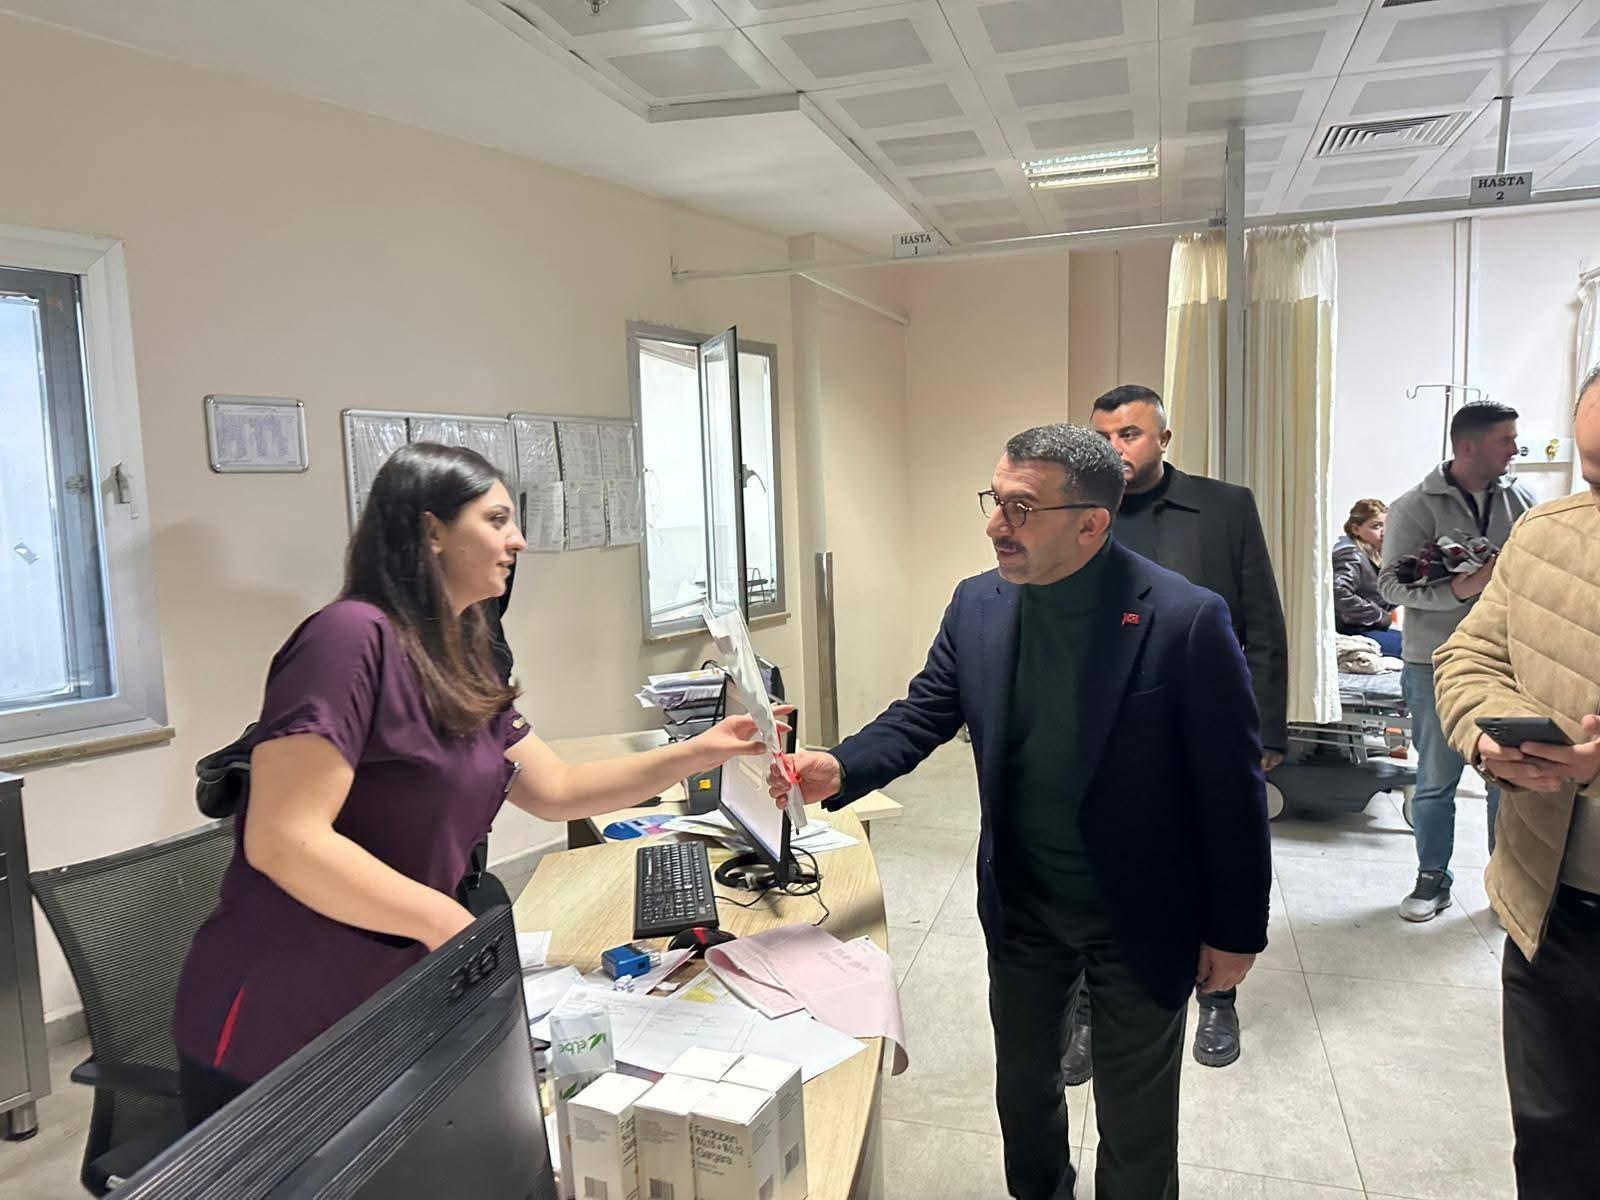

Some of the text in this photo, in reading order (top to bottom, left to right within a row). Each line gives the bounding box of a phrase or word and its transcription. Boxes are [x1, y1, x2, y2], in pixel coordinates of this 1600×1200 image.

[1479, 176, 1525, 189] HASTA
[1496, 191, 1505, 200] 2
[901, 234, 931, 246] HASTA
